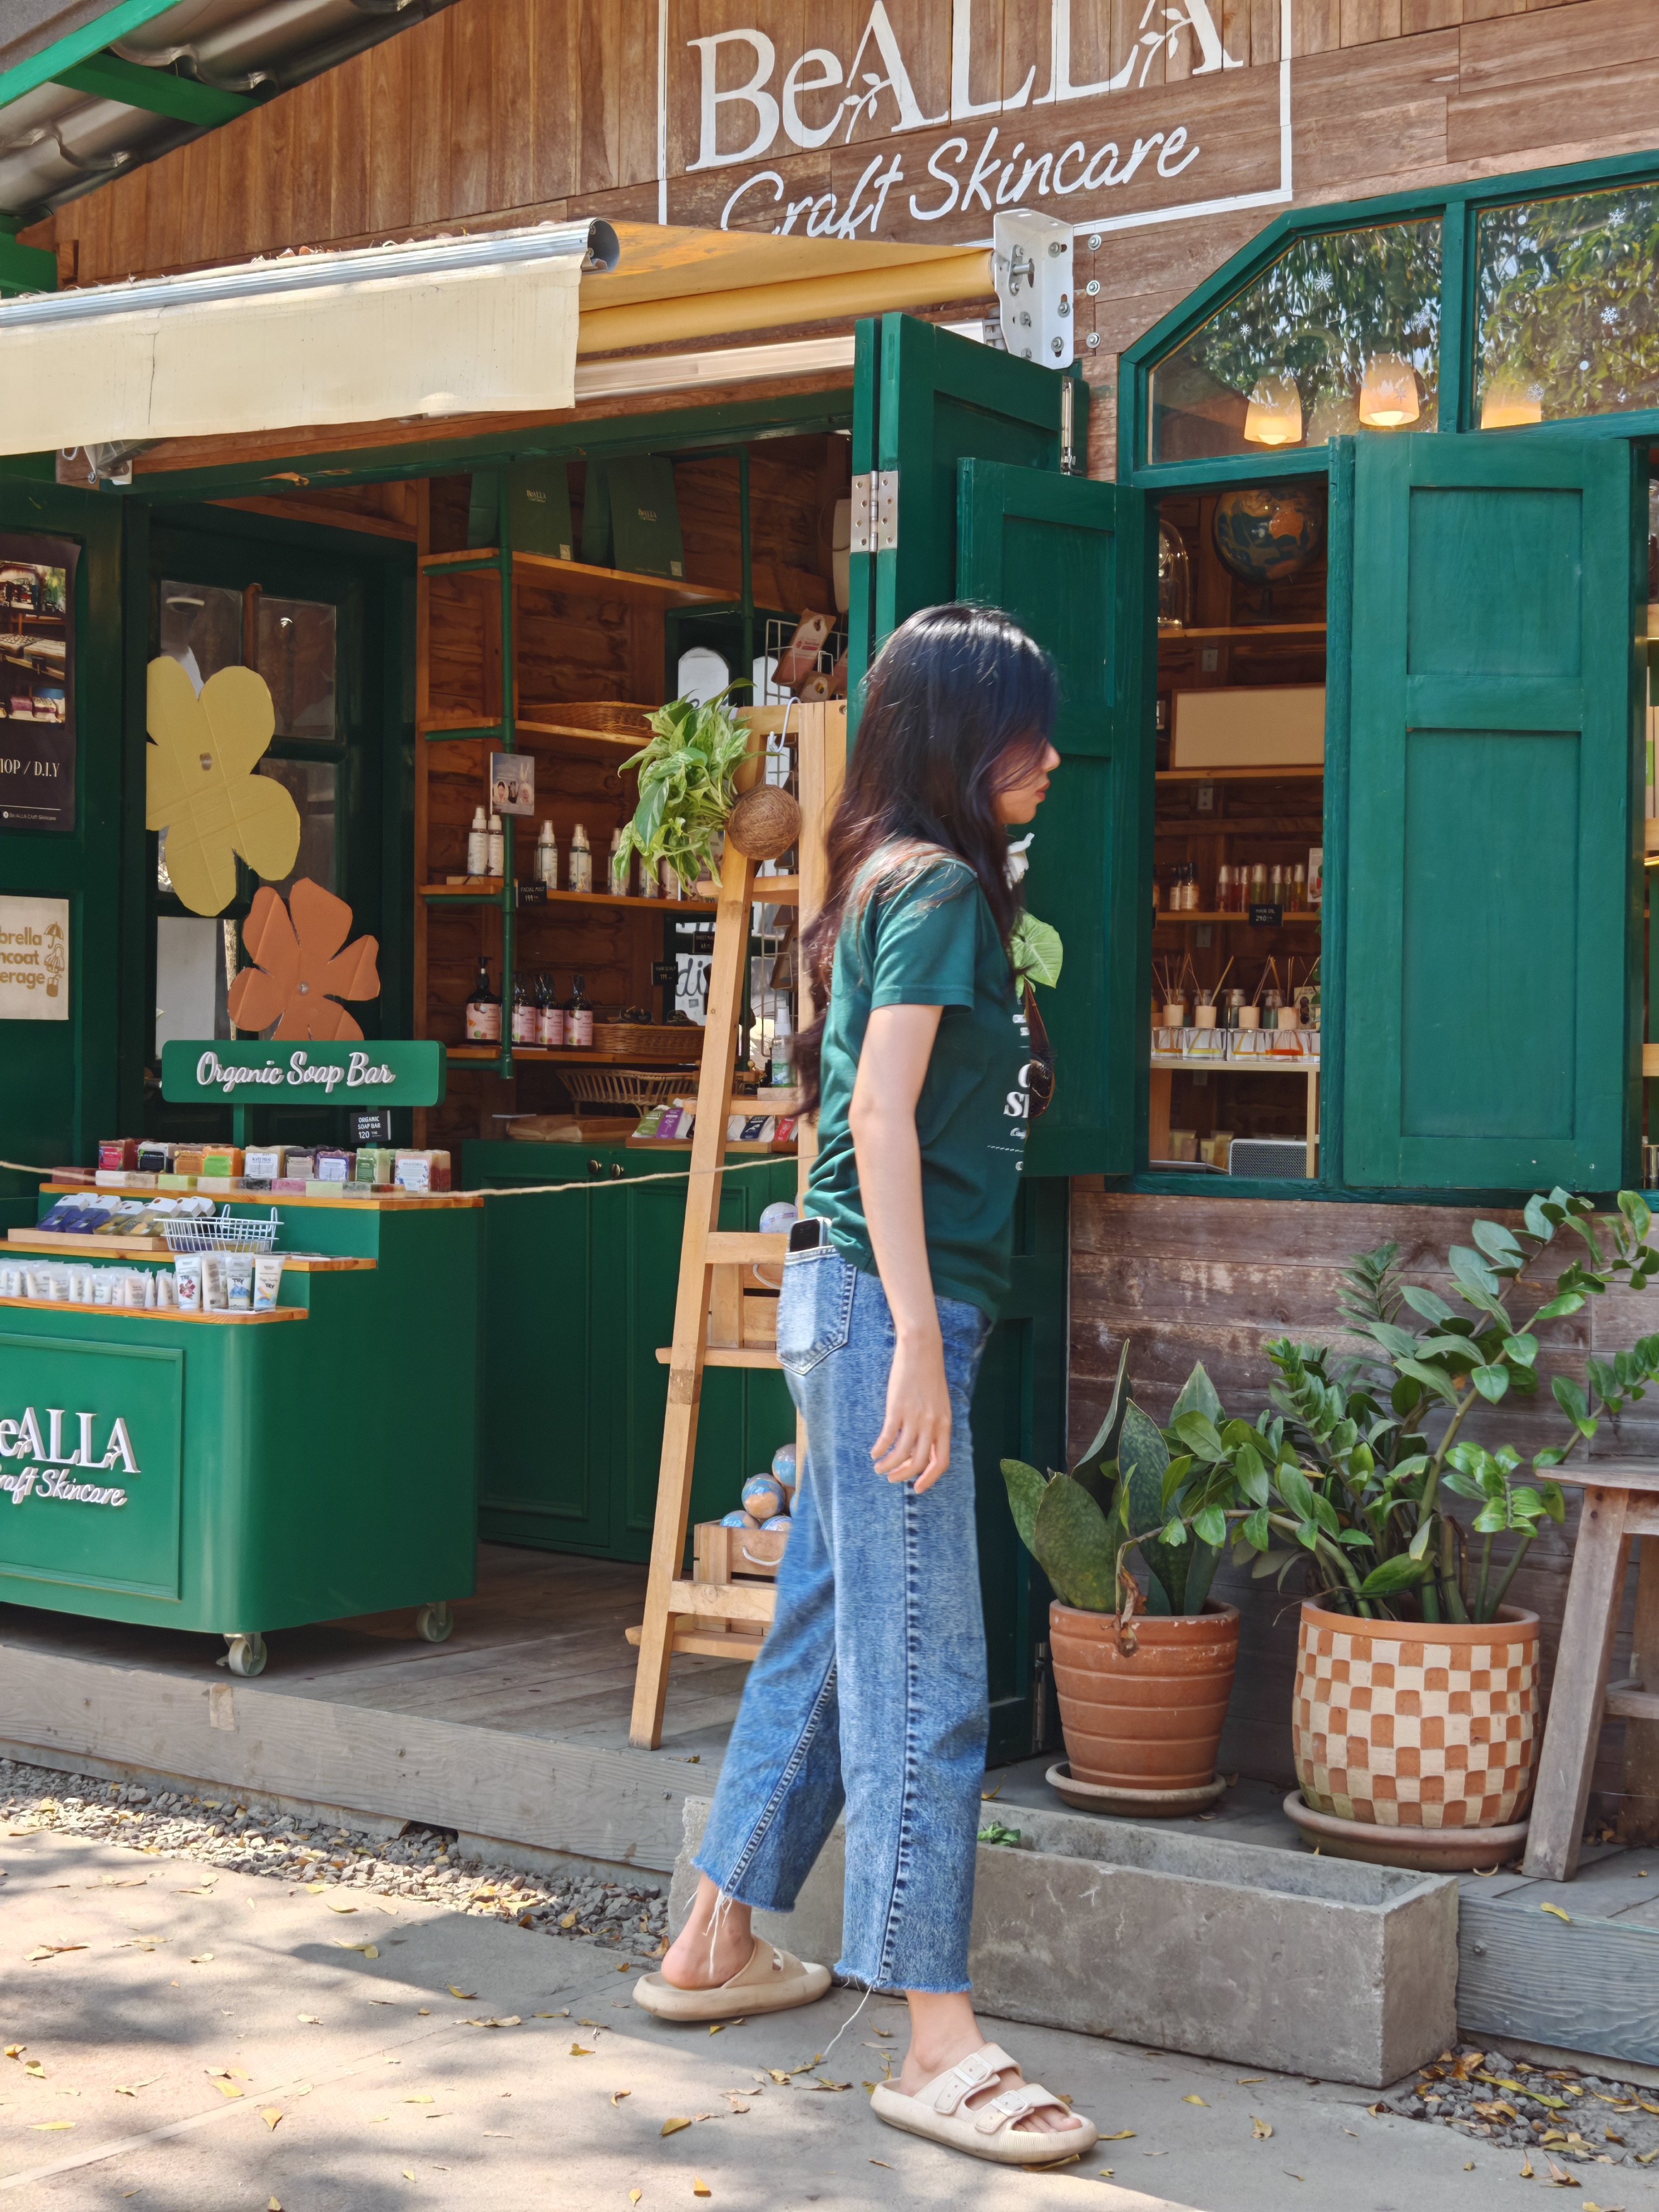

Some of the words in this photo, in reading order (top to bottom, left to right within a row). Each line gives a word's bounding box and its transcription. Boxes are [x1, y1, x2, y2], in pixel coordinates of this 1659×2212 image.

[686, 0, 1244, 172] BeALLA
[720, 153, 904, 240] Craft
[909, 126, 1200, 220] Skincare
[35, 761, 60, 777] D.I.Y
[0, 972, 45, 990] erage
[197, 1051, 285, 1092] Organic
[287, 1051, 345, 1092] Soap
[347, 1052, 396, 1087] Bar
[359, 1131, 370, 1139] 120
[0, 1466, 39, 1505] raft
[36, 1468, 128, 1506] Skincare
